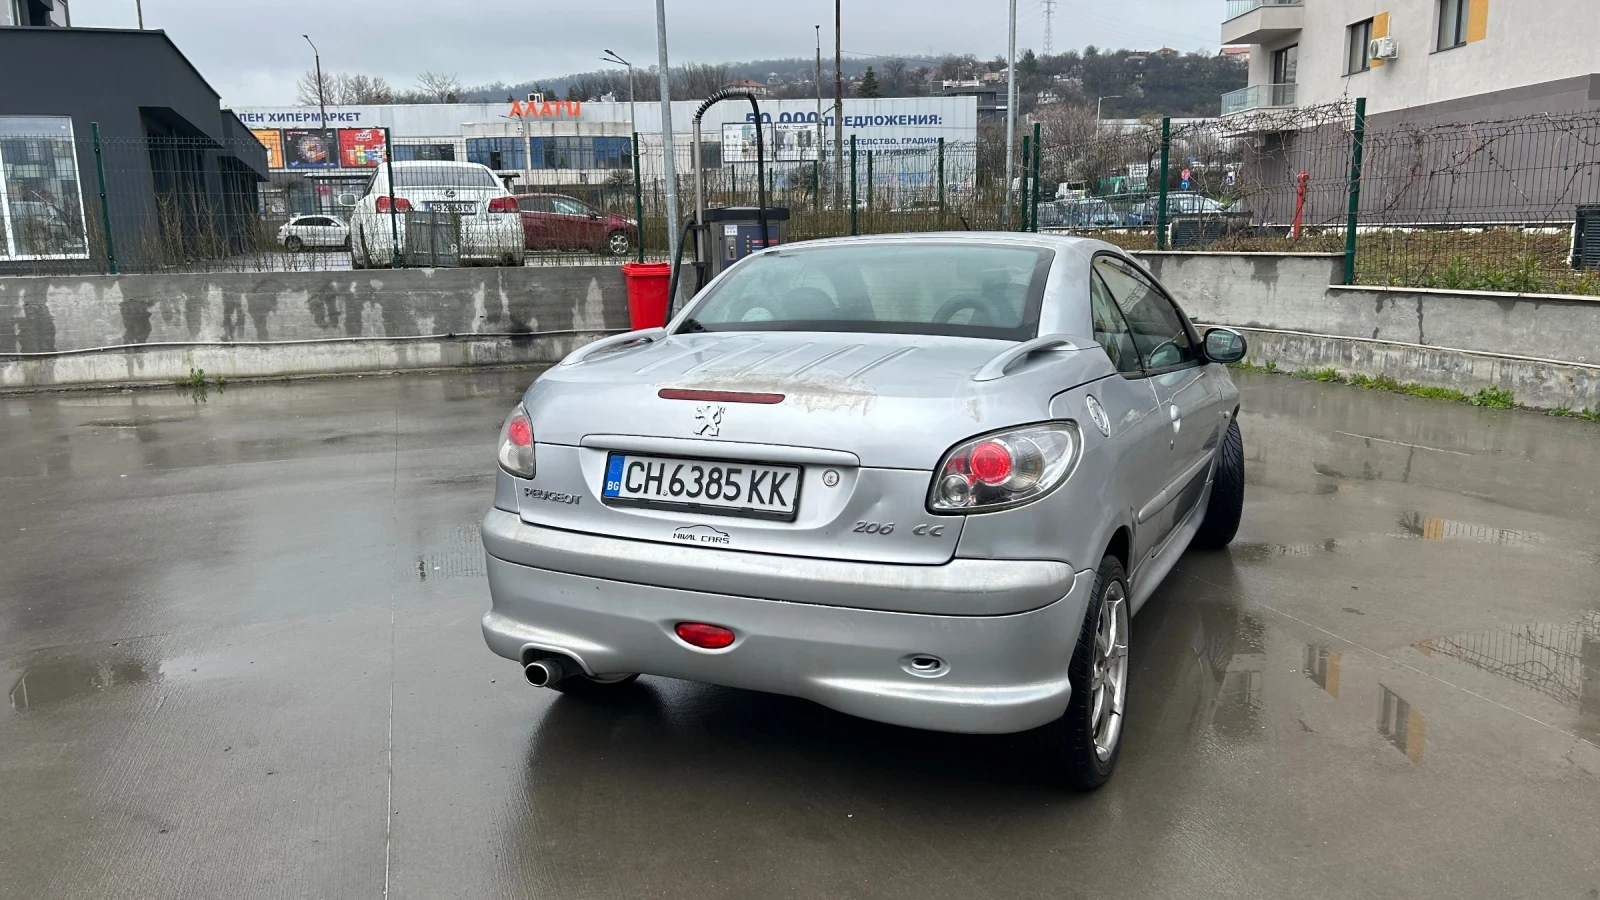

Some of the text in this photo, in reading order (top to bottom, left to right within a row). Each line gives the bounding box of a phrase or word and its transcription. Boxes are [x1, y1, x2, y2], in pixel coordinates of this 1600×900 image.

[268, 112, 361, 122] ХИПЕРМАРКЕТ
[824, 114, 942, 129] ПЕДЛОЖЕНИЯ:
[827, 138, 899, 146] СОТЕЛСТВО,
[606, 461, 791, 506] BG CH 6385 KK
[523, 486, 582, 505] PEUGEOT
[852, 519, 895, 536] 206
[672, 532, 730, 545] NIVAL CARS
